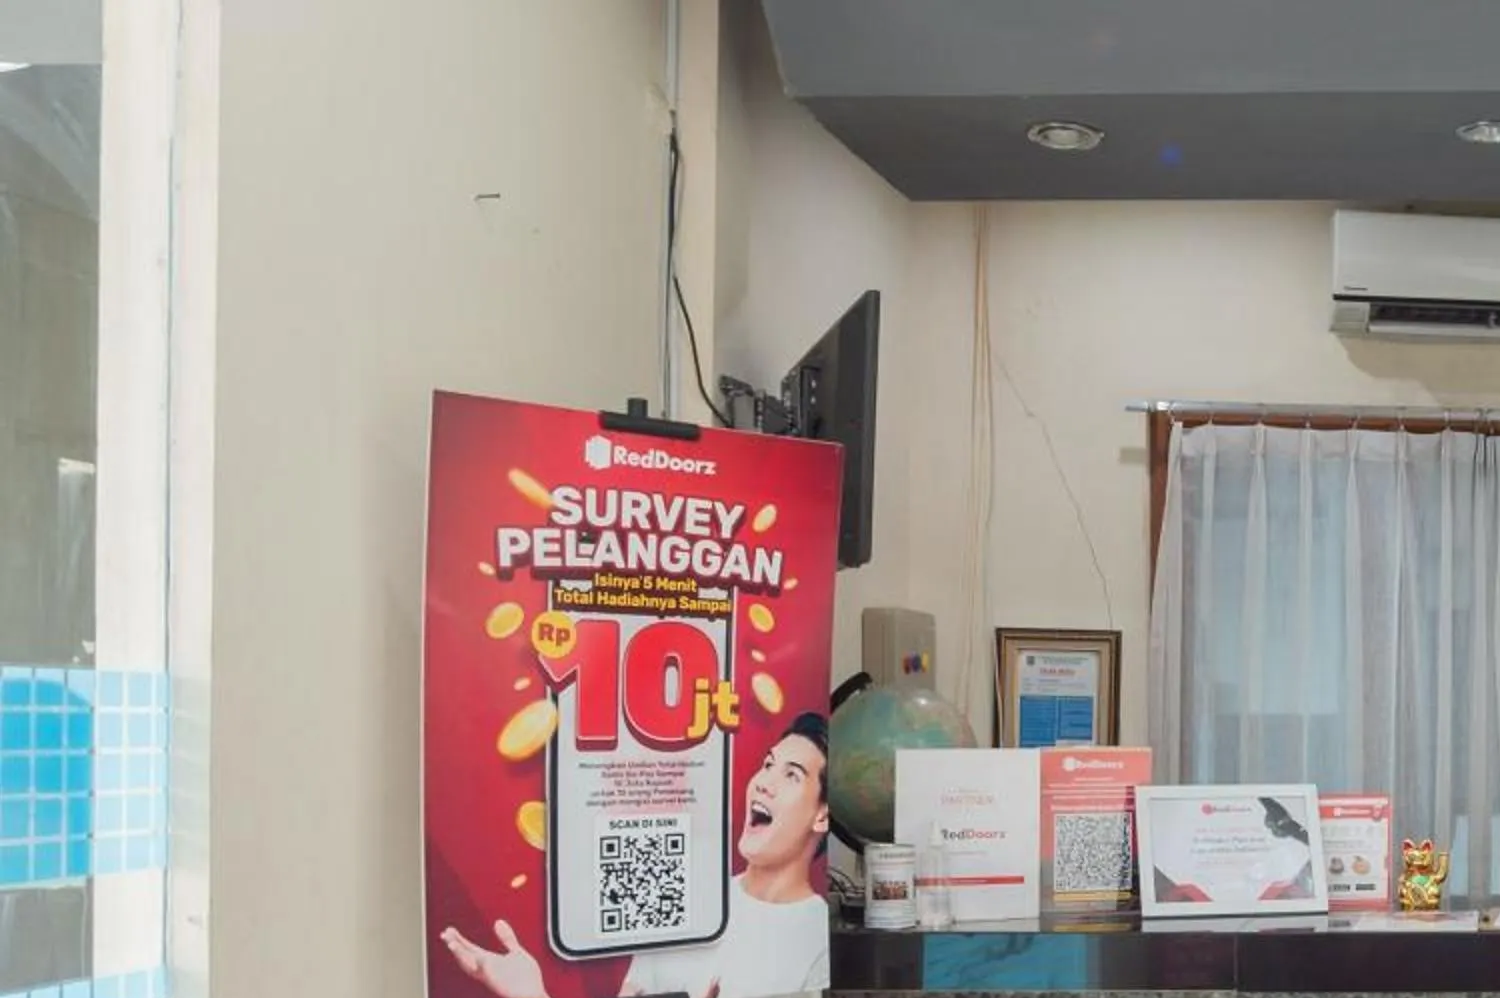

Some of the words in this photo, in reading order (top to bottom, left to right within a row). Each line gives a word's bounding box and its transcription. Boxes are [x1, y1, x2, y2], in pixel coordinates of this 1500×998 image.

[613, 445, 717, 476] RedDoorz
[550, 485, 745, 540] SURVEY
[496, 526, 783, 587] PELANGGAN
[655, 576, 698, 593] Menit
[554, 588, 593, 605] Total
[596, 592, 678, 610] Hadiahnya
[679, 597, 731, 613] Sampai
[537, 622, 571, 647] Rp
[538, 618, 720, 750] 10
[686, 677, 741, 740] jt
[609, 819, 640, 830] SCAN
[641, 819, 653, 829] DI
[656, 818, 678, 828] SINI
